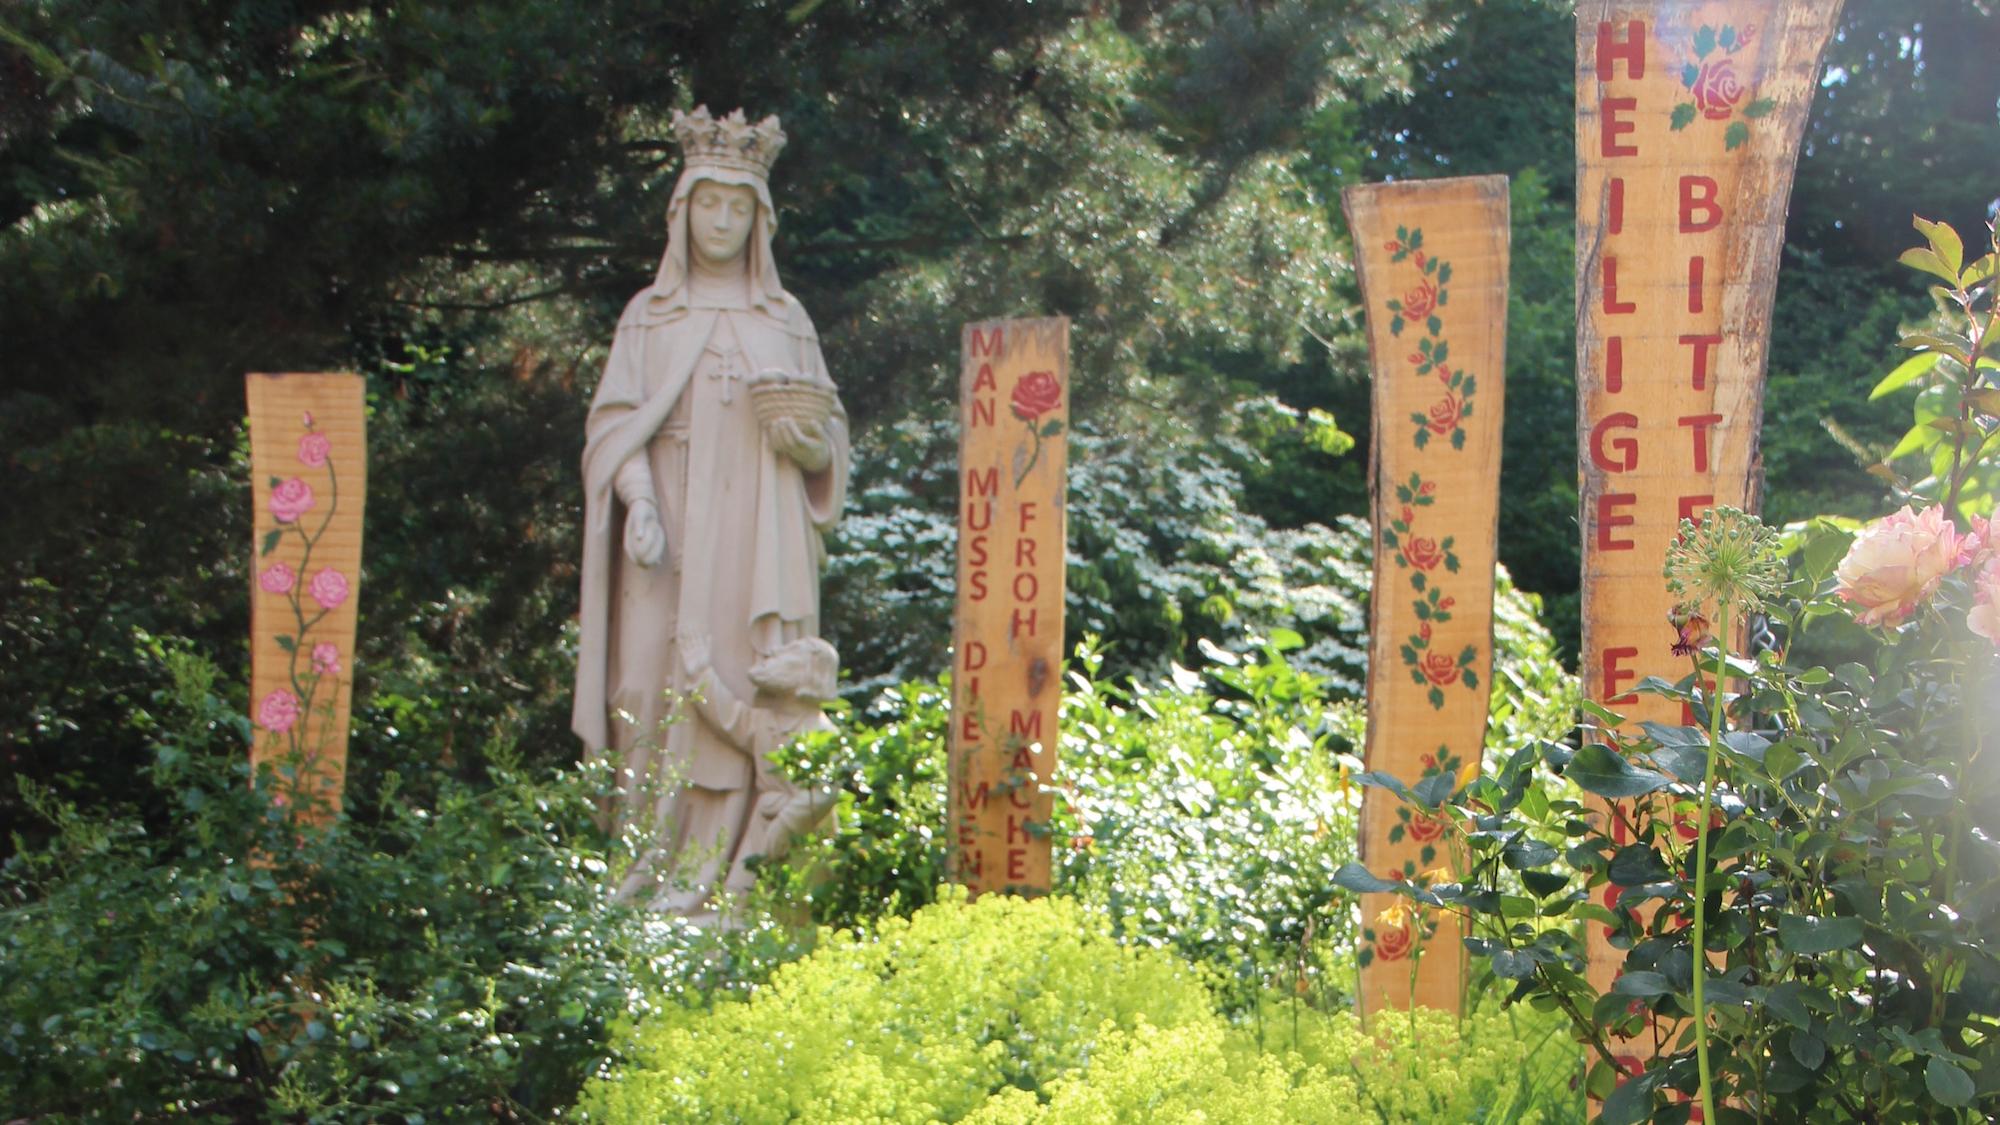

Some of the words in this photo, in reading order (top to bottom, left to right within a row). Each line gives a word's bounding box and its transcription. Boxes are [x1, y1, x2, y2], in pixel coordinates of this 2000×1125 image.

[1589, 20, 1646, 551] HEILIGE
[970, 327, 1004, 428] MAN
[966, 466, 999, 601] MUSS
[1012, 502, 1039, 639] FROH
[962, 640, 988, 742] DIE
[957, 781, 990, 893] MEN
